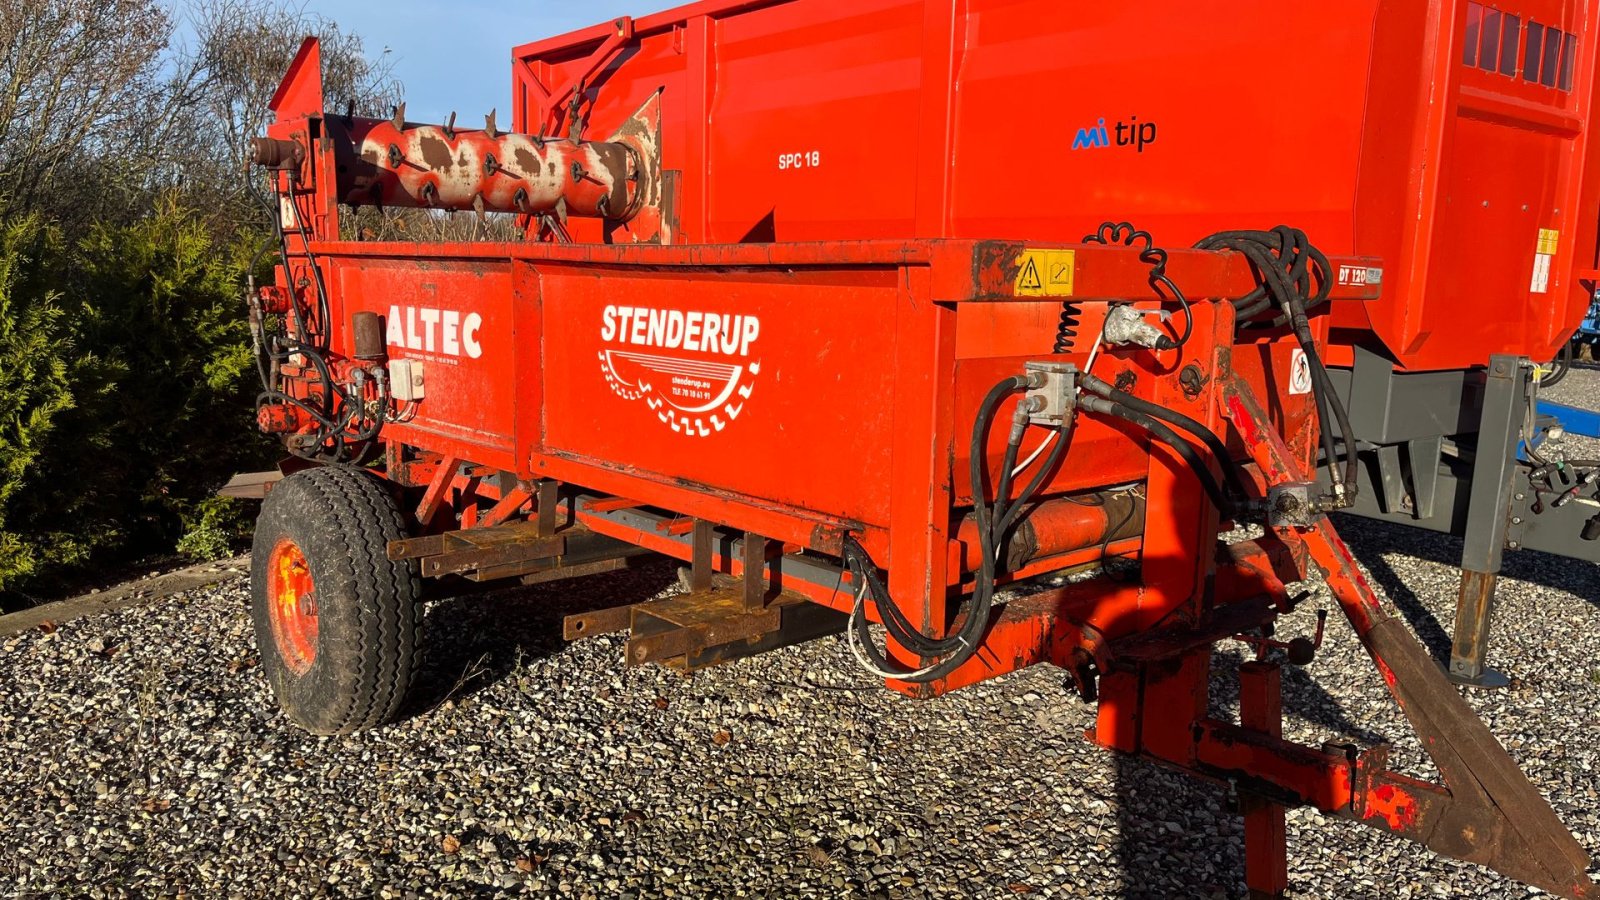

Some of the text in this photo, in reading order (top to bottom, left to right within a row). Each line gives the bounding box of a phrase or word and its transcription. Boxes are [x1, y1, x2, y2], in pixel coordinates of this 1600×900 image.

[1072, 115, 1156, 153] mi tip
[779, 151, 819, 169] SPC 18
[1339, 267, 1350, 282] DT
[1352, 269, 1366, 283] 120
[386, 305, 482, 359] ALTEC
[601, 305, 760, 356] STENDERUP
[672, 376, 710, 389] stenderup.eu
